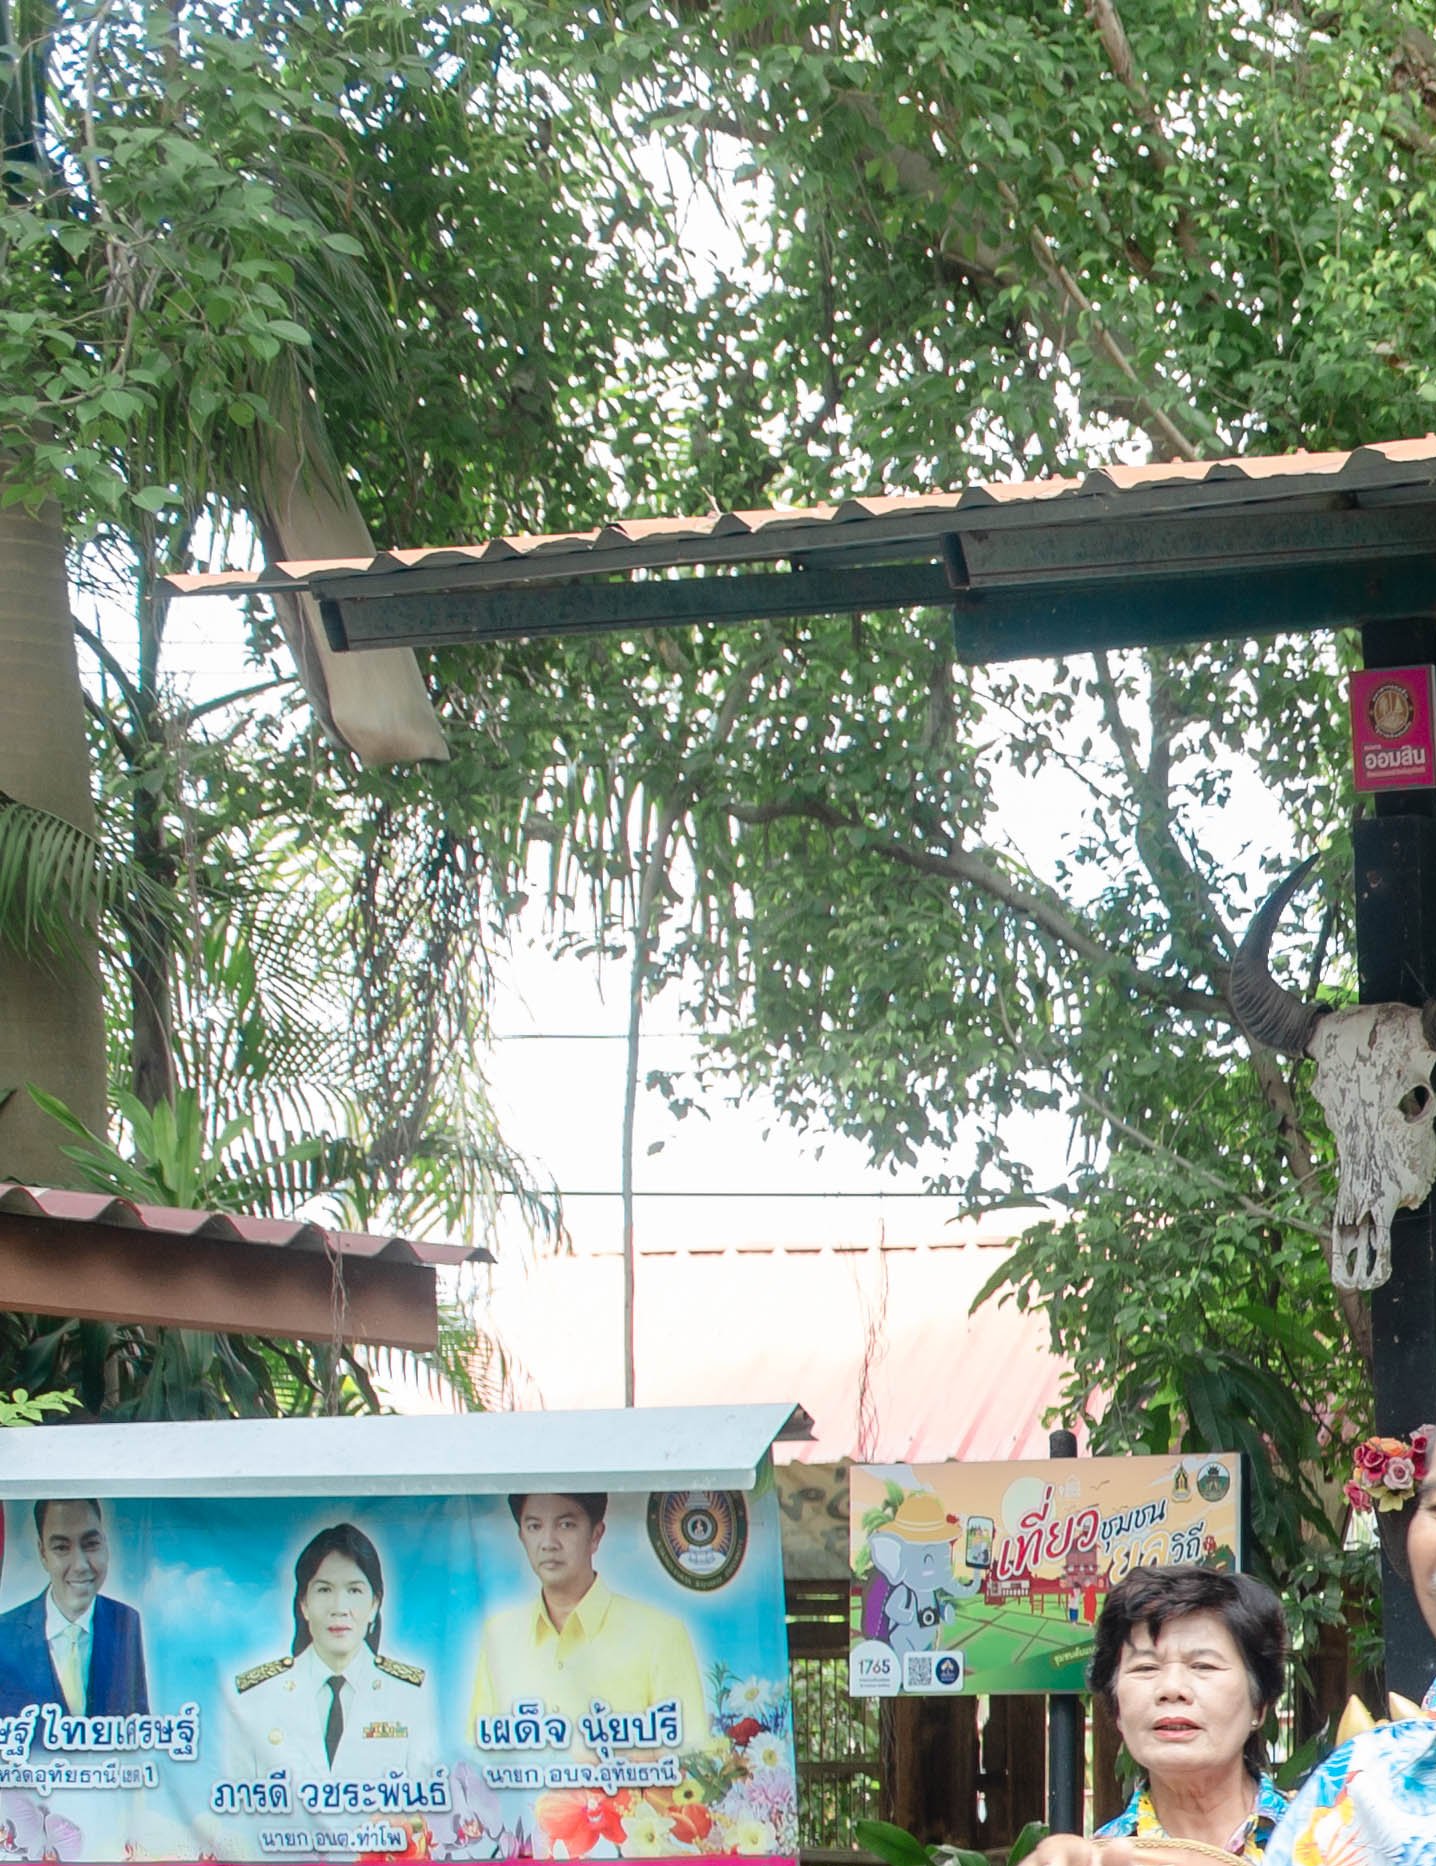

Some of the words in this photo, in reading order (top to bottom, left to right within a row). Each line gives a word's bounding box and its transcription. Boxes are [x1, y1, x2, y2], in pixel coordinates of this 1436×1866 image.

[1365, 745, 1426, 769] ออมสิน
[859, 1659, 891, 1675] 1765
[46, 1706, 196, 1756] ไทยเศรษฐ์
[481, 1703, 566, 1744] เผด็จ
[582, 1702, 677, 1759] นุ้ยปรี
[145, 1765, 153, 1782] 1
[487, 1768, 538, 1783] นายก
[550, 1759, 676, 1791] อบจ.อุทัยธานี
[214, 1769, 288, 1808] ภารดี
[300, 1769, 445, 1808] วชระพันธ์
[262, 1830, 308, 1847] นายก
[315, 1824, 401, 1848] อบต.ท่าโพ
